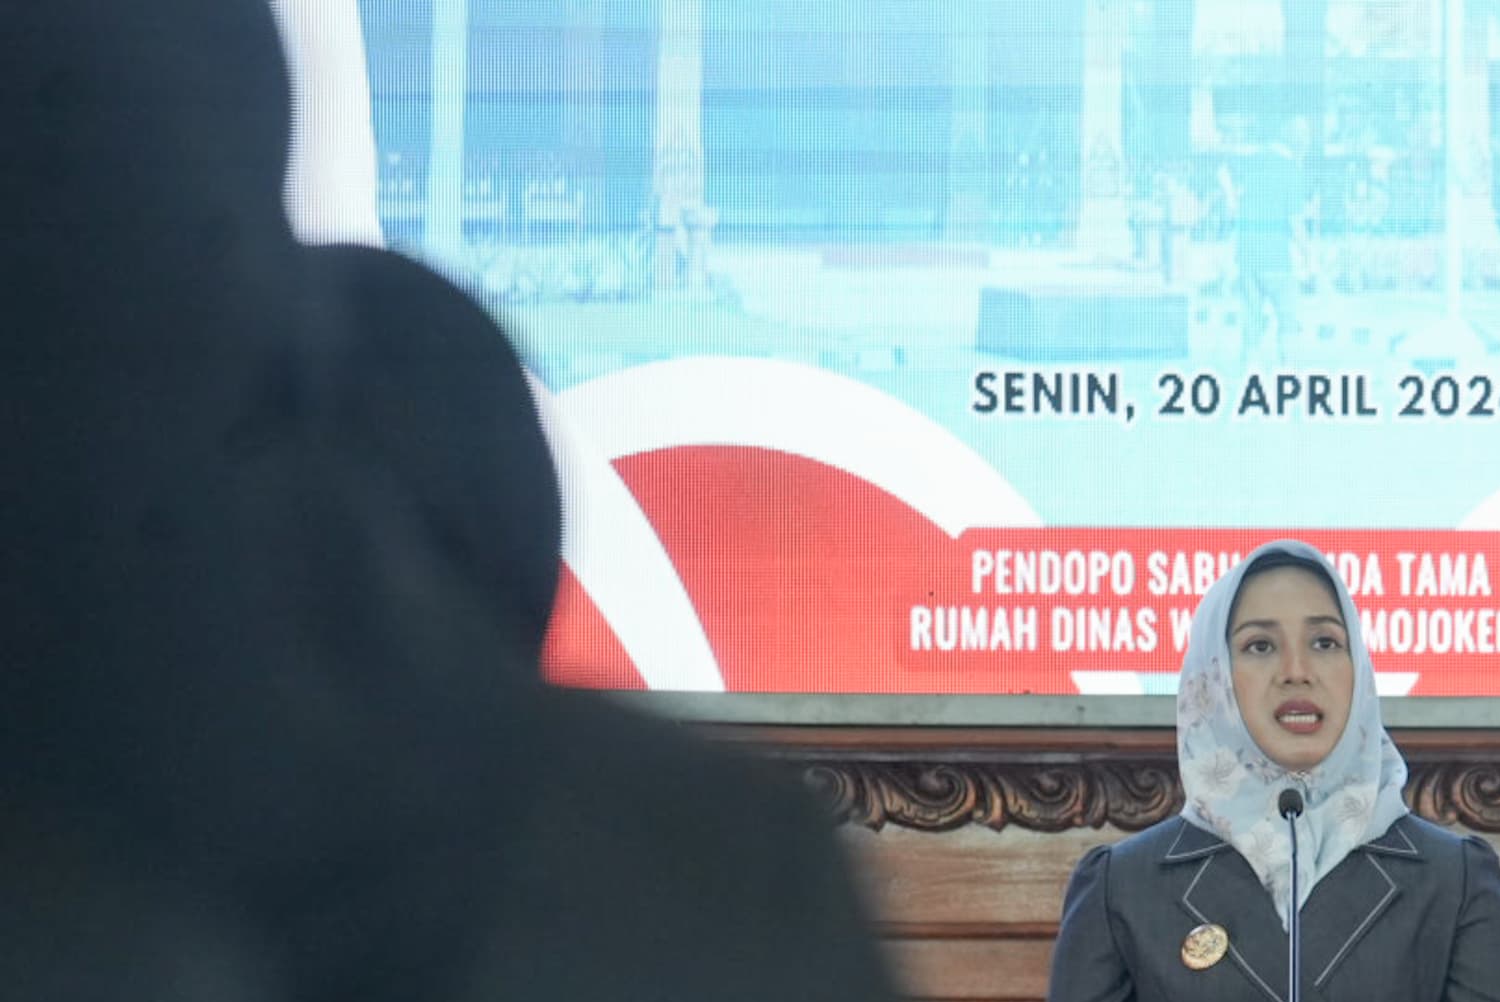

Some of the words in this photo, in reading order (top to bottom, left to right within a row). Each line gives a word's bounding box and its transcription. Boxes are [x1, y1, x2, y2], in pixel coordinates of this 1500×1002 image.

[973, 372, 1136, 421] SENIN,
[1158, 375, 1220, 415] 20
[1238, 375, 1377, 415] APRIL
[972, 550, 1134, 594] PENDOPO
[1397, 552, 1490, 596] TAMA
[911, 606, 1036, 650] RUMAH
[1052, 607, 1157, 652] DINAS
